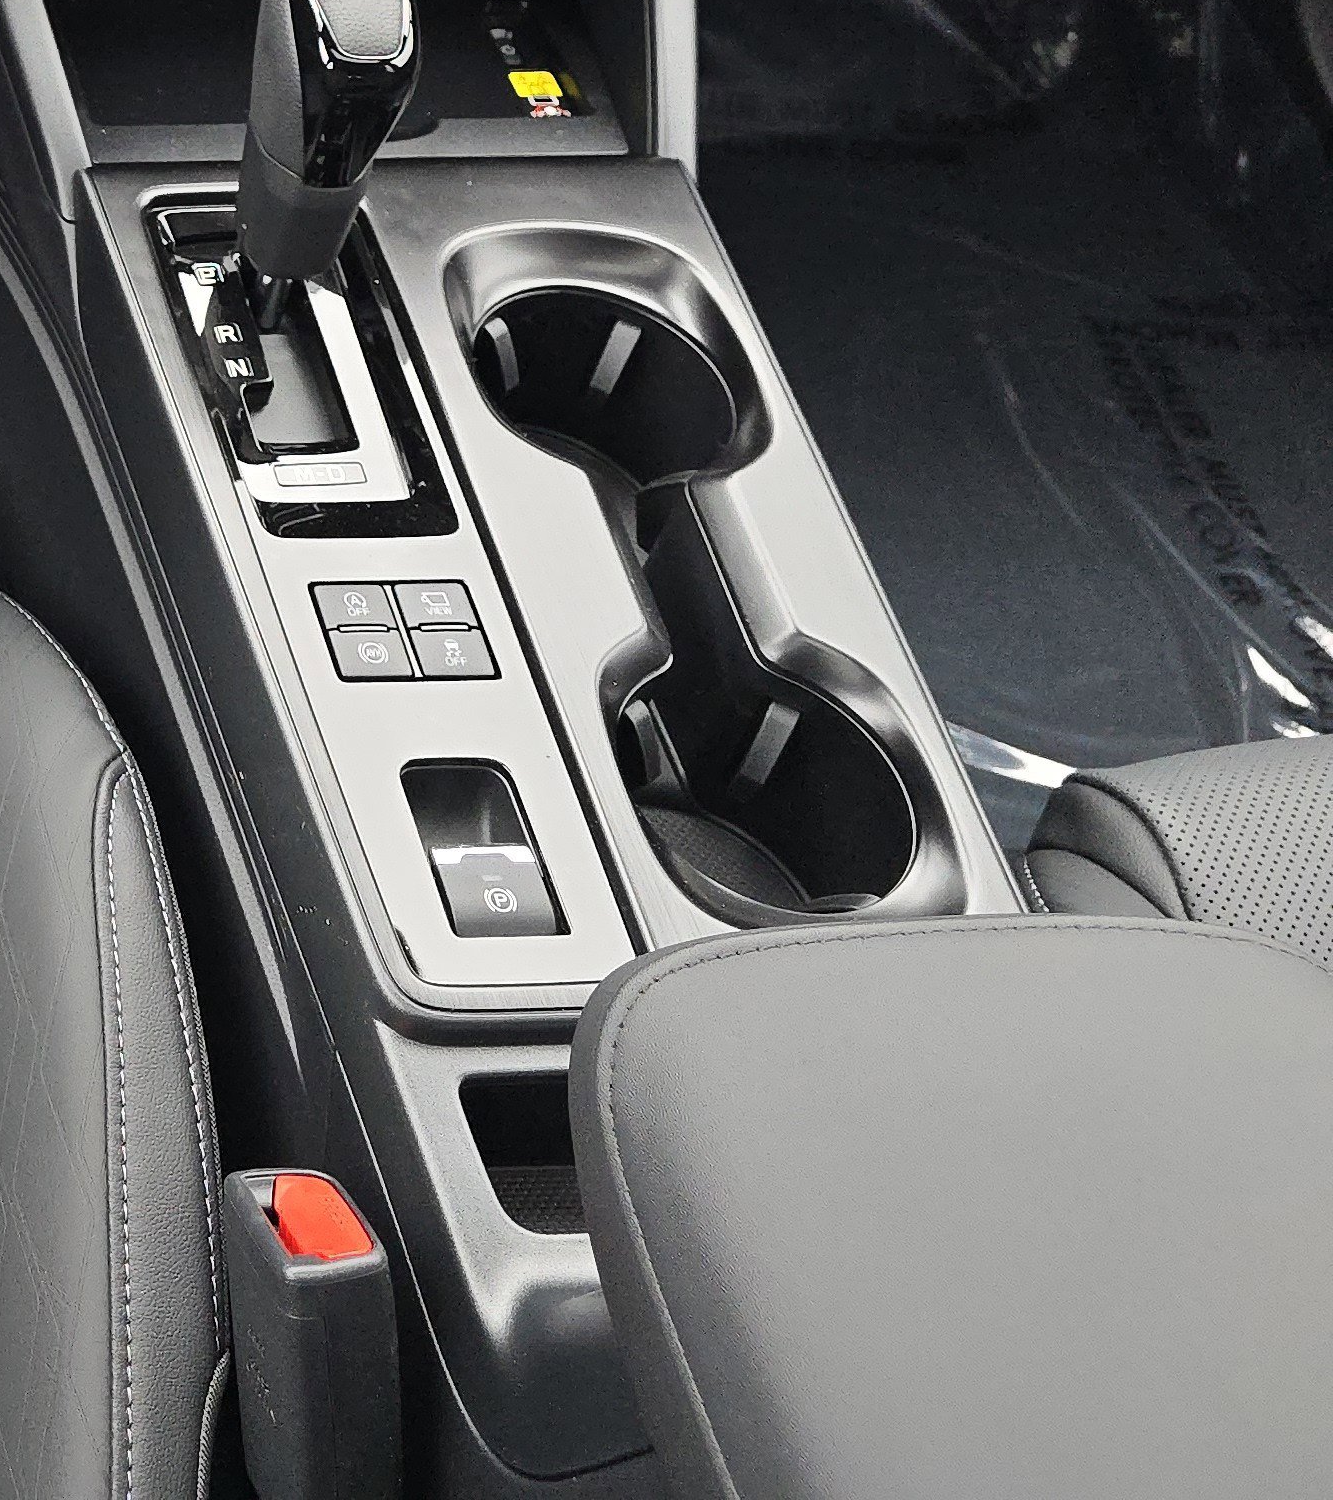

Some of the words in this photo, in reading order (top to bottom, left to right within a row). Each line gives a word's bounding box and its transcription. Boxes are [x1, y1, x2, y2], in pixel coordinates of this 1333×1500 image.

[215, 324, 240, 344] R
[224, 359, 252, 378] N
[347, 607, 371, 617] OFF
[424, 607, 453, 616] VIEW
[444, 656, 467, 667] OFF
